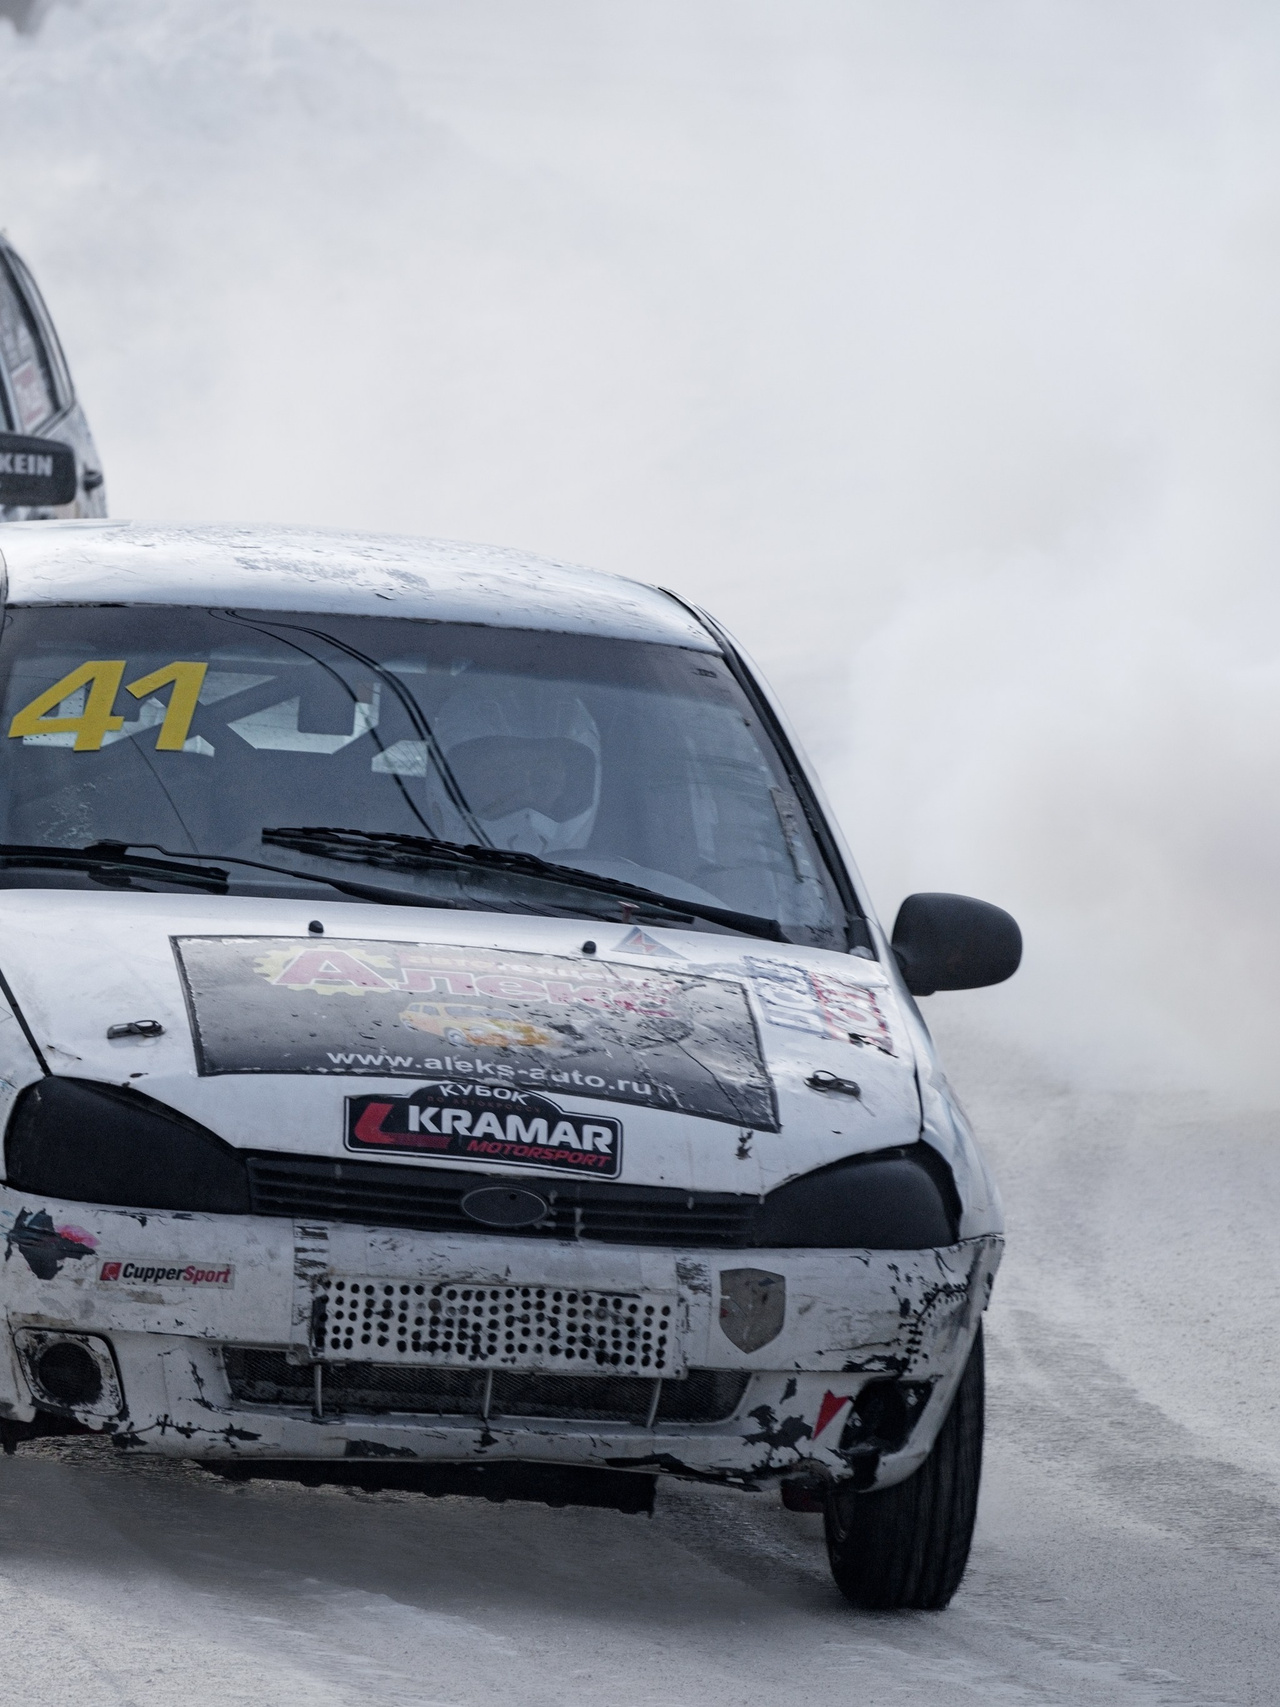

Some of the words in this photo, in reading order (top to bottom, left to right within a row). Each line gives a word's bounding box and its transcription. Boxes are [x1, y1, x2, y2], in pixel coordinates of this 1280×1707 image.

[8, 660, 208, 752] 41
[326, 1051, 653, 1097] www.aleks-auto.ru
[439, 1084, 530, 1106] КУБОК
[408, 1105, 614, 1154] KRAMAR
[467, 1140, 612, 1168] MOTORSPORT
[122, 1262, 231, 1284] CupperSport
